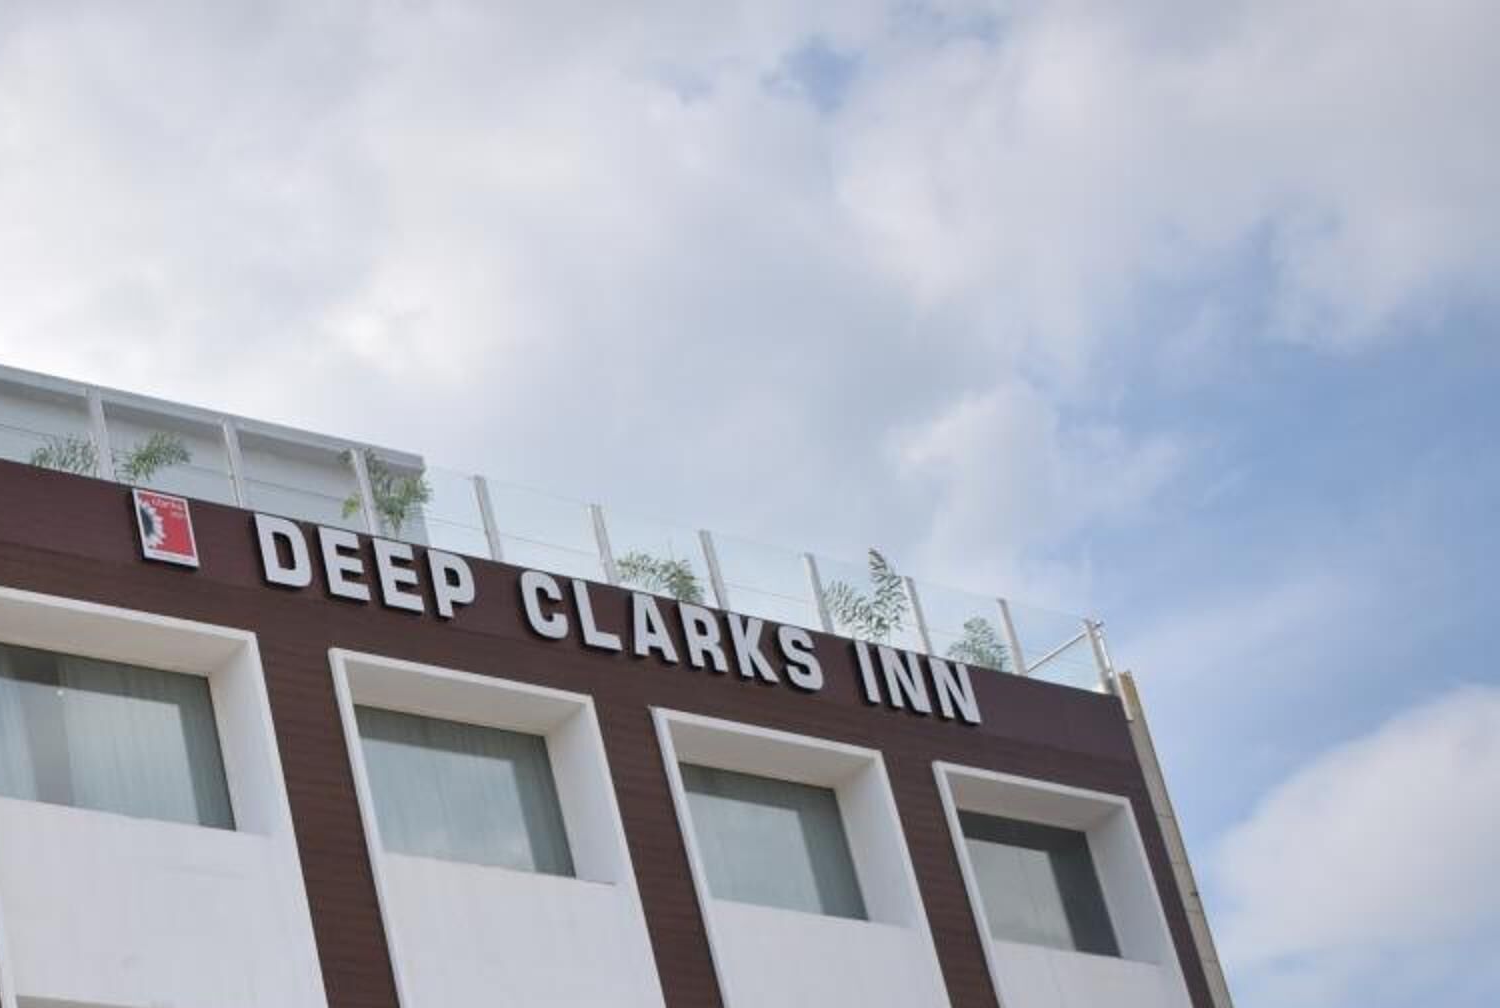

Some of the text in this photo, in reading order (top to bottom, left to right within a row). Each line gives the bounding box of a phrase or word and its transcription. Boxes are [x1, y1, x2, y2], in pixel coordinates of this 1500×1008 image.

[254, 512, 982, 724] DEEP CLARKS INN
